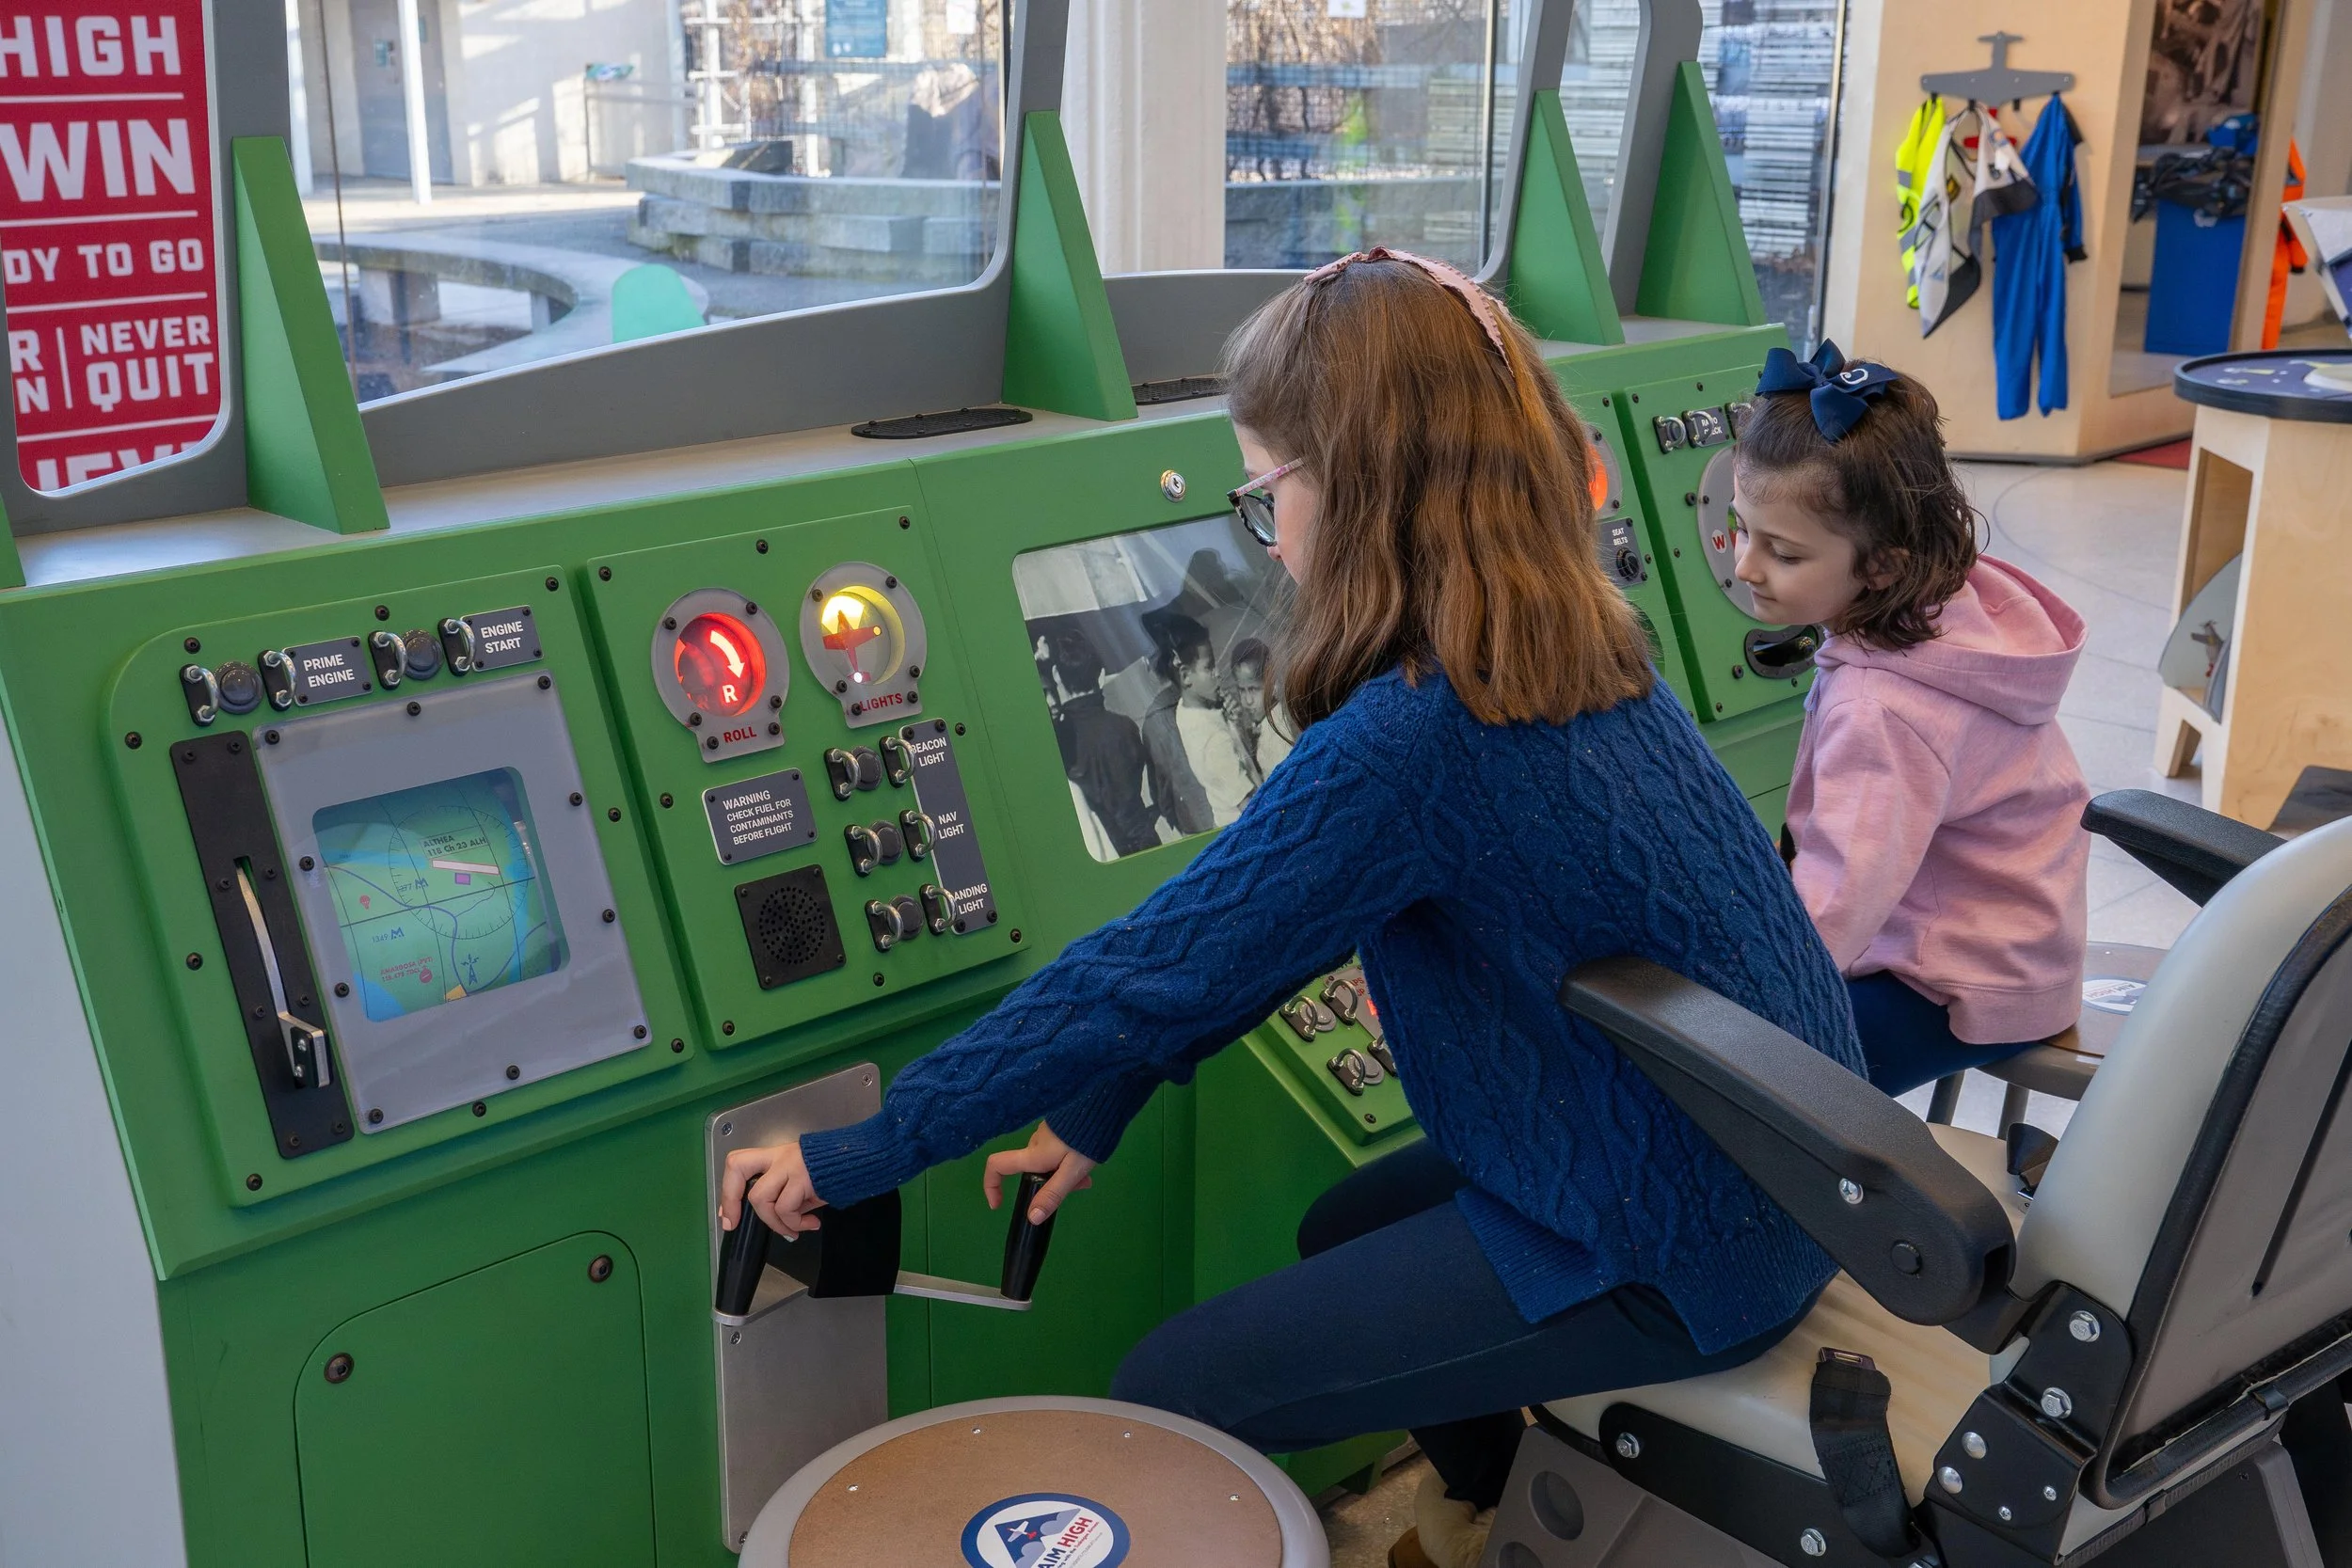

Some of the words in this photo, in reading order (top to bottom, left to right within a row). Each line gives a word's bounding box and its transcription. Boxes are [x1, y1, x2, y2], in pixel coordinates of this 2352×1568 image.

[0, 15, 182, 78] HIGH
[0, 119, 196, 202] WIN
[77, 243, 134, 279] TO
[150, 237, 203, 274] GO
[80, 315, 212, 356] NEVER
[85, 352, 215, 413] QUIT
[1701, 417, 1718, 427] RAO
[1612, 527, 1625, 537] SEAT
[1613, 536, 1629, 546] BELTS
[1712, 533, 1725, 550] W
[480, 620, 524, 640] ENGINE
[485, 636, 522, 655] START
[303, 654, 344, 672] PRIME
[307, 668, 356, 689] ENGINE
[722, 684, 738, 704] R
[859, 692, 903, 711] LIGHTS
[723, 726, 757, 743] ROLL
[911, 736, 947, 753] BEACON
[918, 752, 945, 768] LIGHT
[723, 790, 771, 810] WARNING
[726, 807, 755, 822] CHECK
[755, 802, 775, 815] FUEL
[775, 798, 792, 810] FOR
[938, 811, 957, 825] NAV
[730, 810, 794, 833] CONTAMINANTS
[938, 823, 964, 839] LIGHT
[423, 835, 454, 847] ALTHEA
[733, 830, 765, 845] BEFORE
[764, 822, 792, 837] FLIGHT
[427, 847, 442, 857] 118
[444, 844, 455, 852] Ch
[470, 836, 487, 847] ALH
[953, 883, 988, 902] ANDING
[959, 898, 985, 915] LIGHT
[1038, 1547, 1067, 1568] AIM
[1057, 1516, 1093, 1547] HIGH
